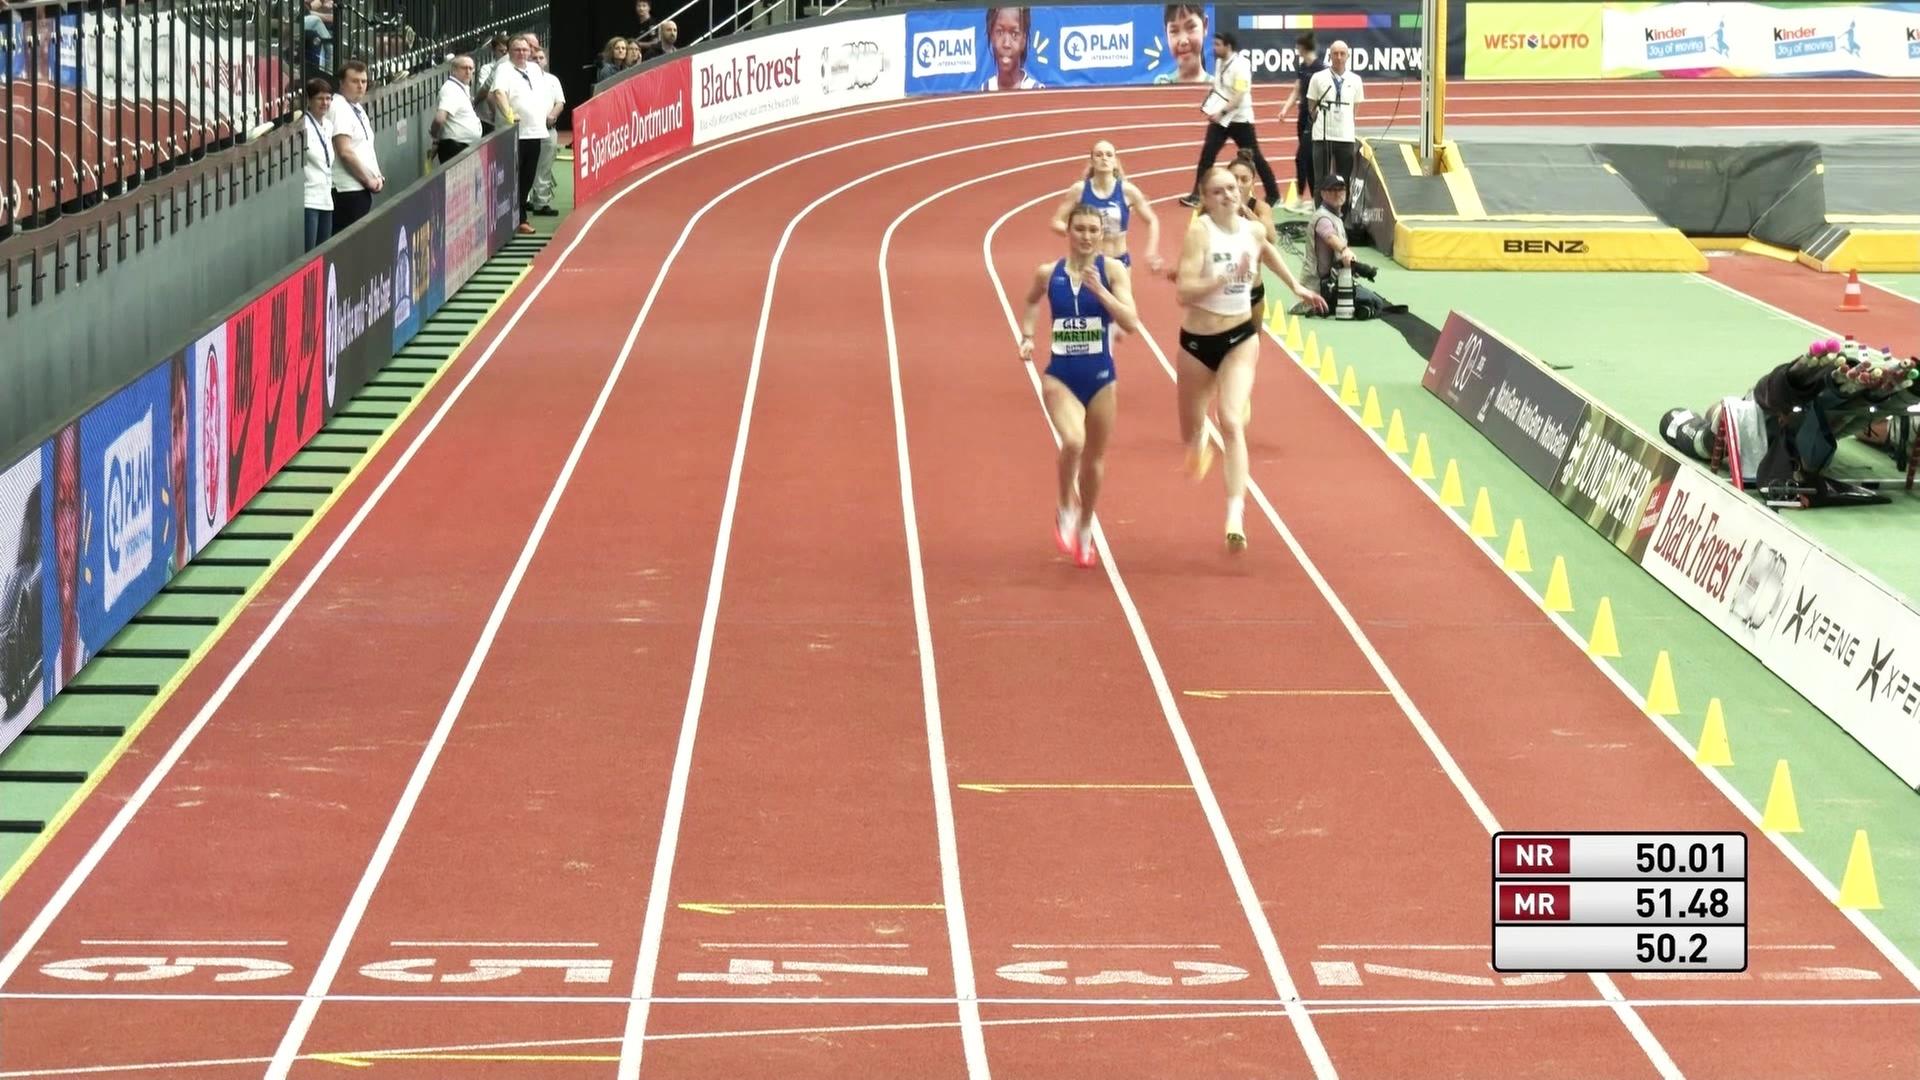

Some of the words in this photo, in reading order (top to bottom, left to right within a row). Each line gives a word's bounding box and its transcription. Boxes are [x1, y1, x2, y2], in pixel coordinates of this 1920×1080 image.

[938, 36, 972, 57] PLAN
[1090, 33, 1129, 51] PLAN
[1484, 34, 1526, 49] WEST
[1541, 34, 1589, 49] LOTTO
[1675, 39, 1704, 52] moving
[1804, 39, 1833, 52] moving
[700, 58, 743, 108] Black
[746, 48, 801, 95] Forest
[591, 124, 629, 180] Sparkasse
[631, 90, 683, 148] Dortmund
[1503, 240, 1584, 254] BENZ
[1062, 317, 1087, 329] GLS
[1054, 330, 1099, 341] MARTIN
[125, 443, 150, 516] PLAN
[1573, 433, 1652, 529] BUNDESWEHR
[1653, 489, 1706, 574] Black
[1686, 512, 1747, 603] Forest
[1804, 609, 1860, 667] XPENG
[358, 958, 613, 983] 5
[677, 959, 928, 983] 4
[995, 960, 1250, 985] 3
